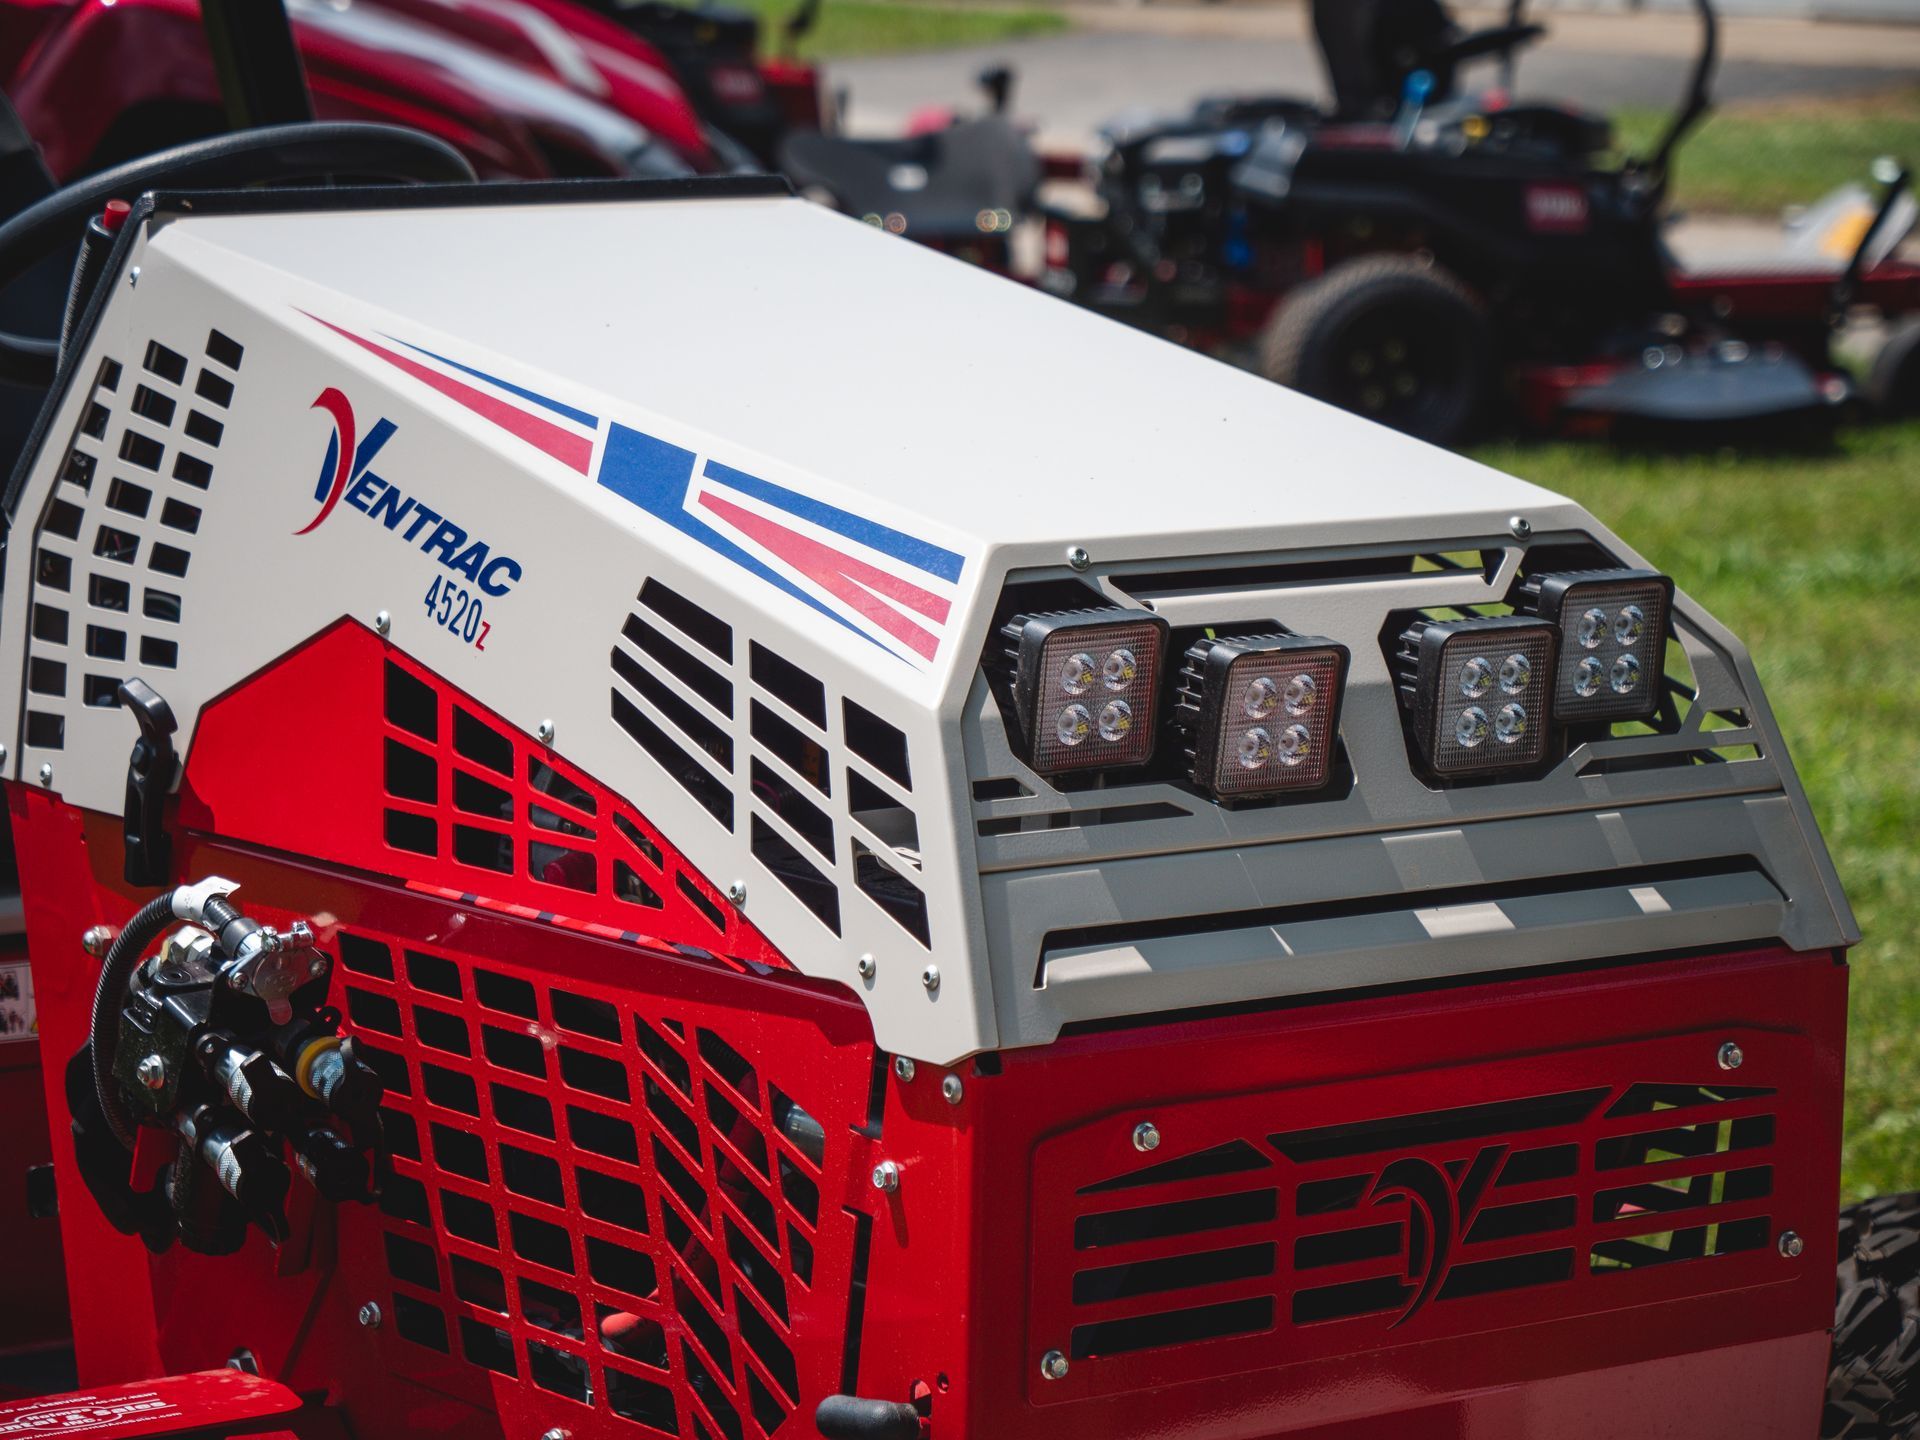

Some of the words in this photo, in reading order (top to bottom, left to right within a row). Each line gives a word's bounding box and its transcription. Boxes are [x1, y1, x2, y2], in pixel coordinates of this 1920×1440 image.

[291, 387, 522, 597] VENTRAC
[26, 1408, 92, 1420] Holmes
[65, 1413, 87, 1421] &
[92, 1401, 166, 1416] Sales
